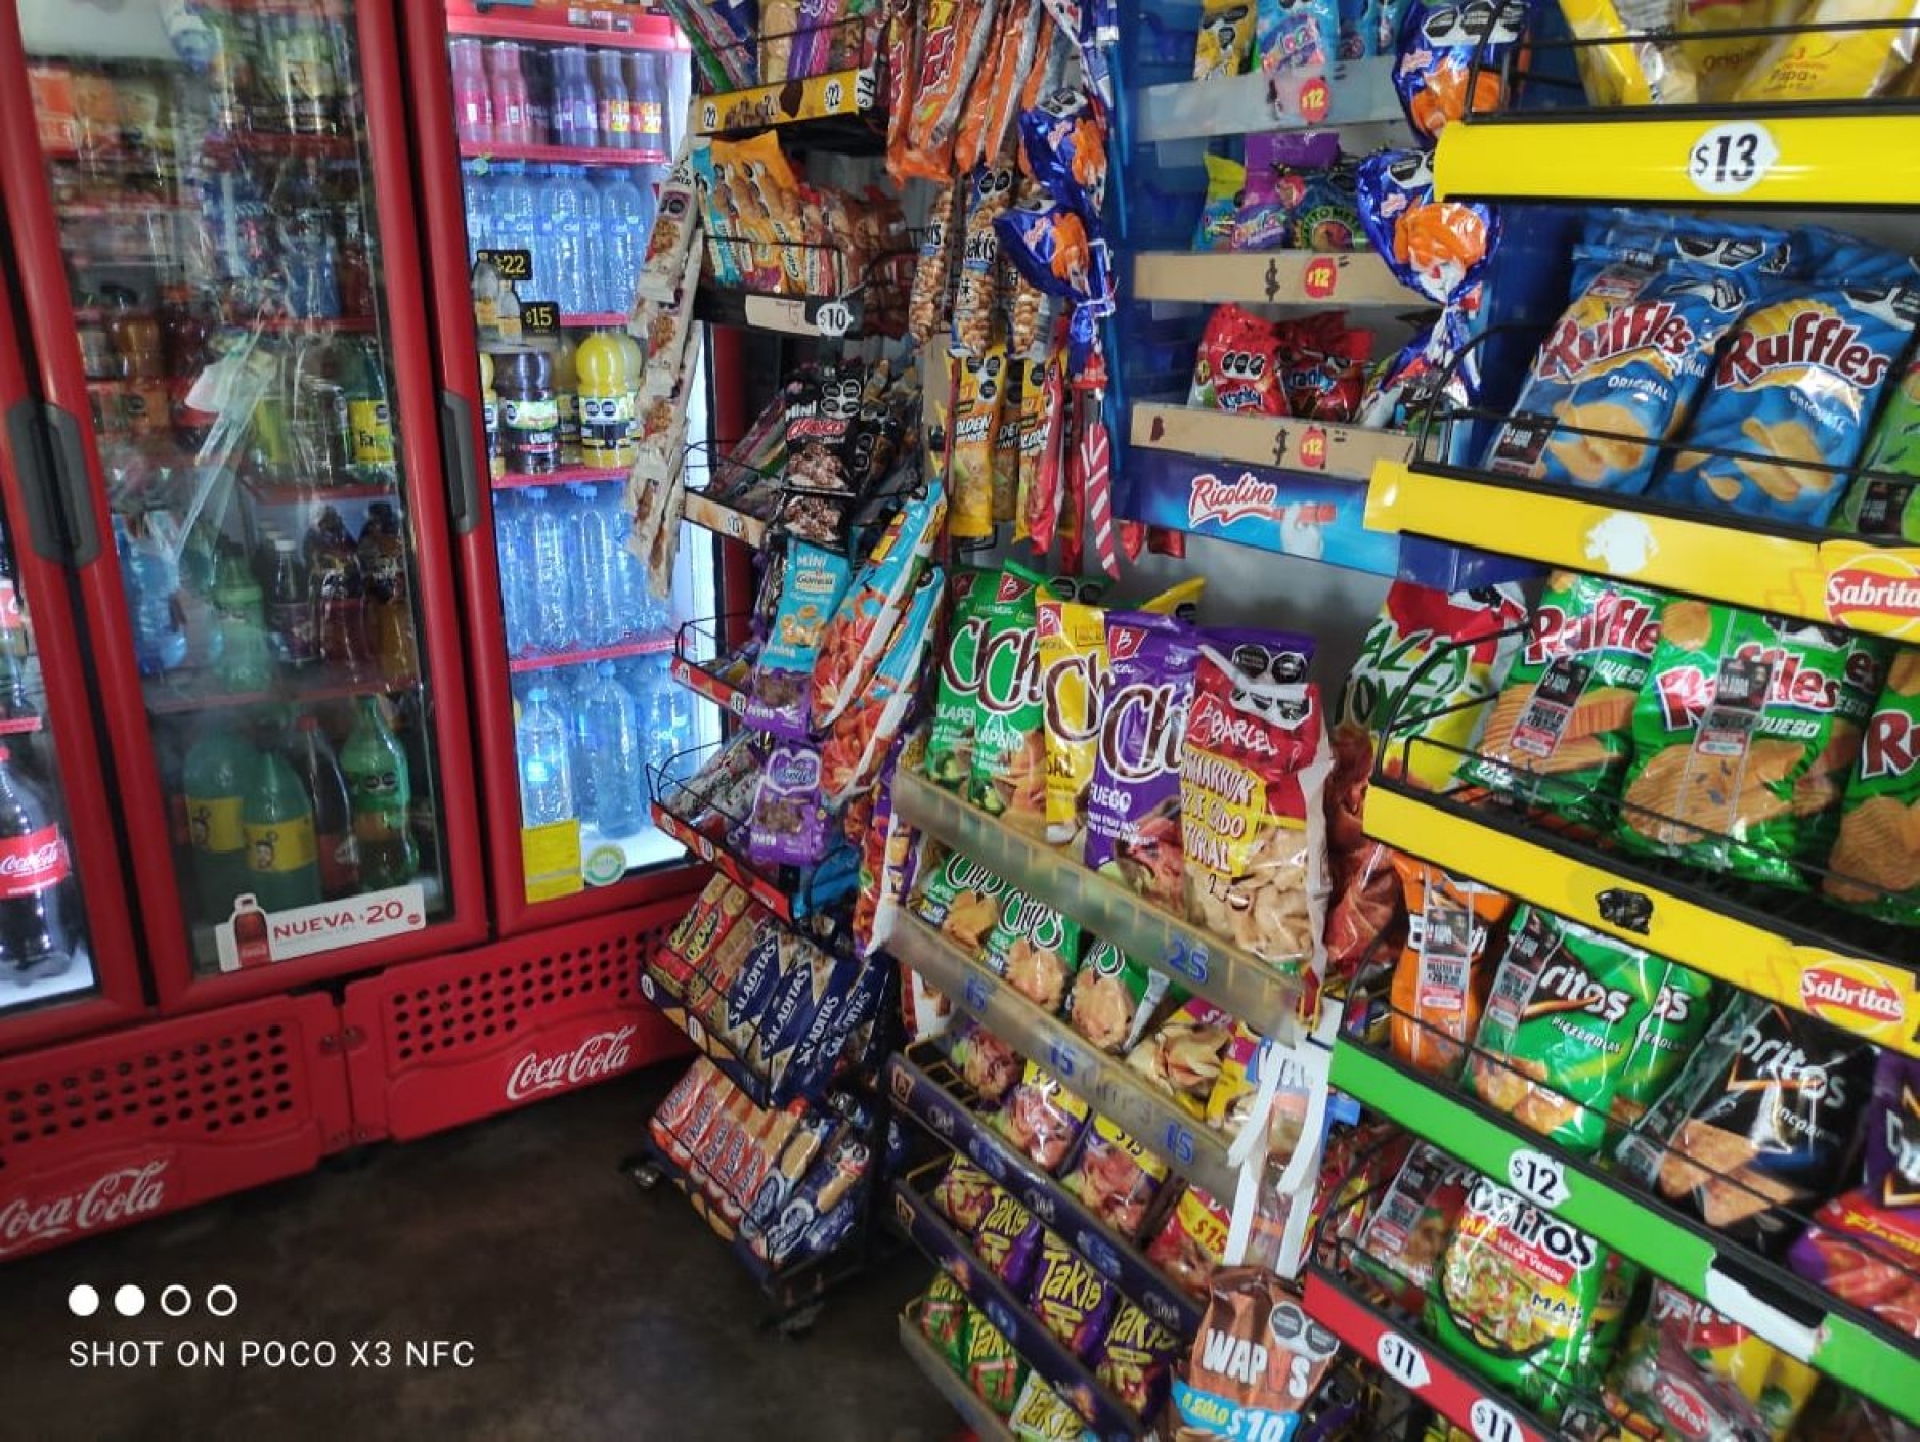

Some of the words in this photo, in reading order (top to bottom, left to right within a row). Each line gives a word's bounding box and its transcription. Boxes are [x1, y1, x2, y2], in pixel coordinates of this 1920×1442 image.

[1694, 133, 1759, 182] $13
[525, 306, 552, 327] $15
[818, 309, 847, 331] $10
[1537, 300, 1693, 381] Ruffles
[1716, 311, 1891, 389] Ruffles
[1190, 474, 1277, 515] Ricolino
[1826, 575, 1920, 607] Sabrita
[1525, 592, 1664, 665] Ruffle
[273, 911, 356, 941] NUEVA
[1540, 966, 1631, 1021] ritos
[1800, 969, 1905, 1015] Sabritas
[506, 1024, 638, 1100] Coca-Cola
[1512, 1158, 1558, 1201] $12
[1038, 1249, 1102, 1312] Takis
[1383, 1338, 1416, 1379] $11
